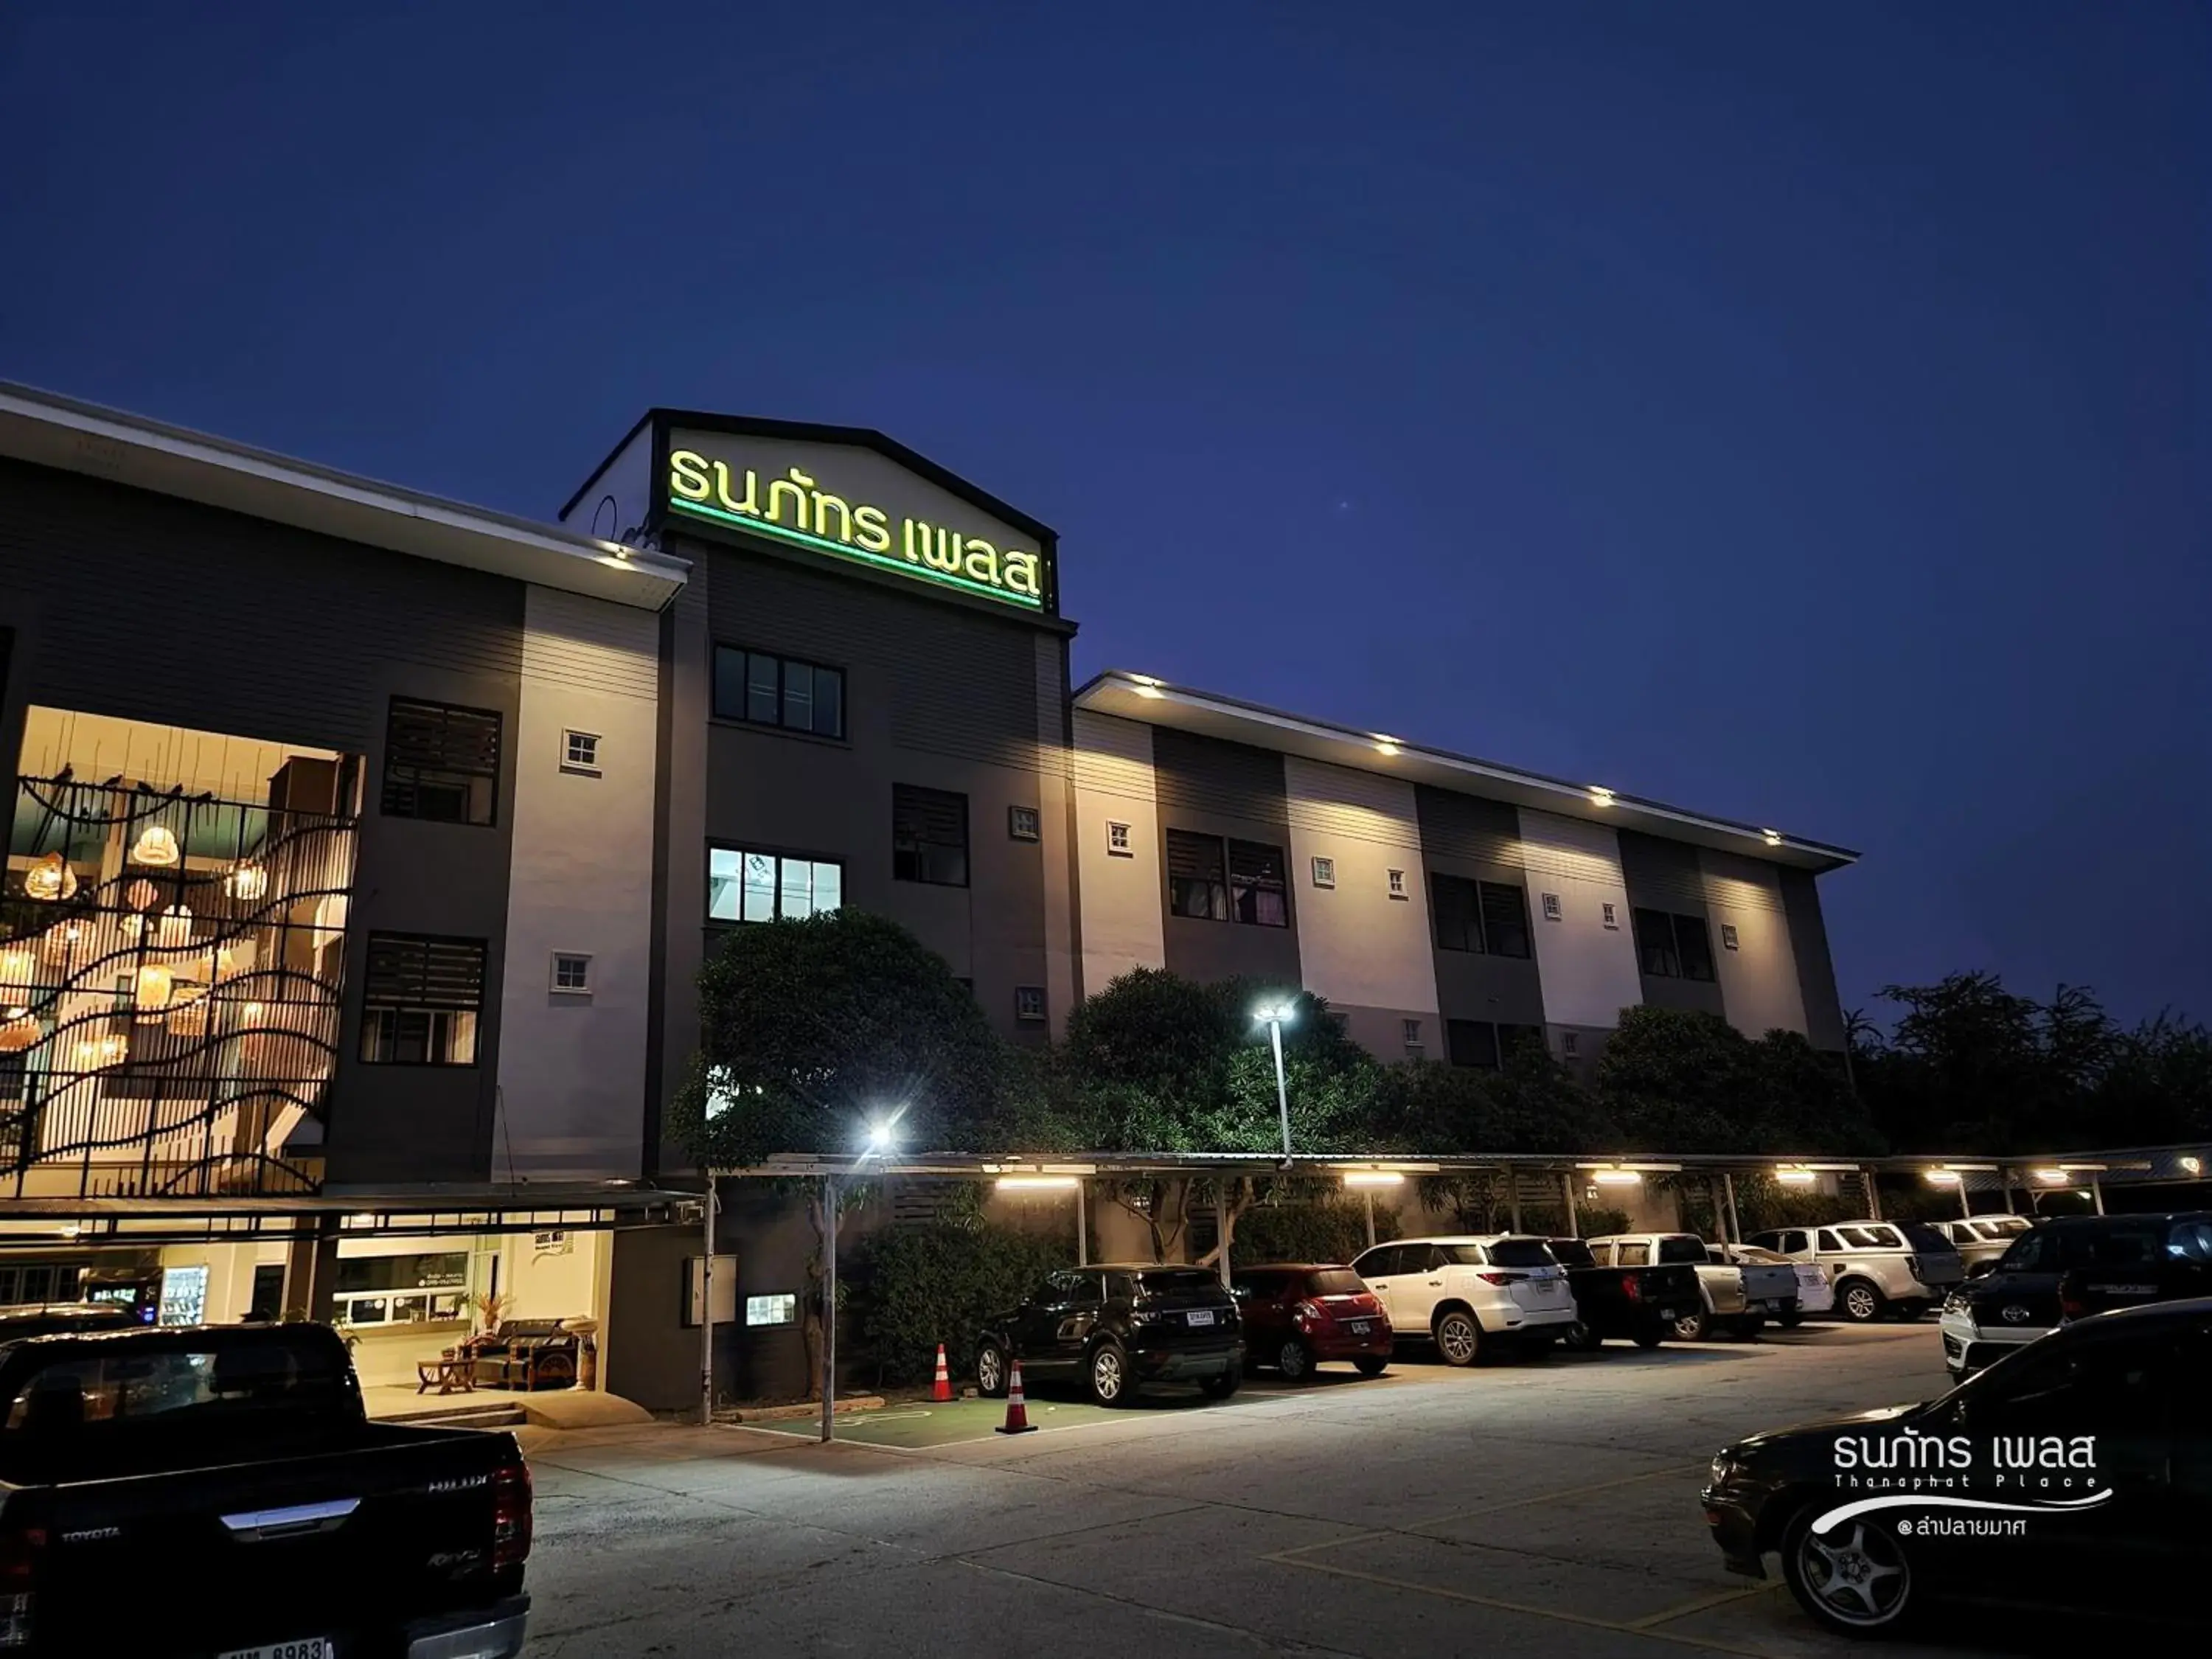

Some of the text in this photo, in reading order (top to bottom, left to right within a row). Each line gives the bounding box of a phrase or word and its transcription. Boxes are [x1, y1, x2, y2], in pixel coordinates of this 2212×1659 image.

[669, 448, 1041, 596] ธนภัทร เพลส
[61, 1526, 122, 1543] TOYOTA
